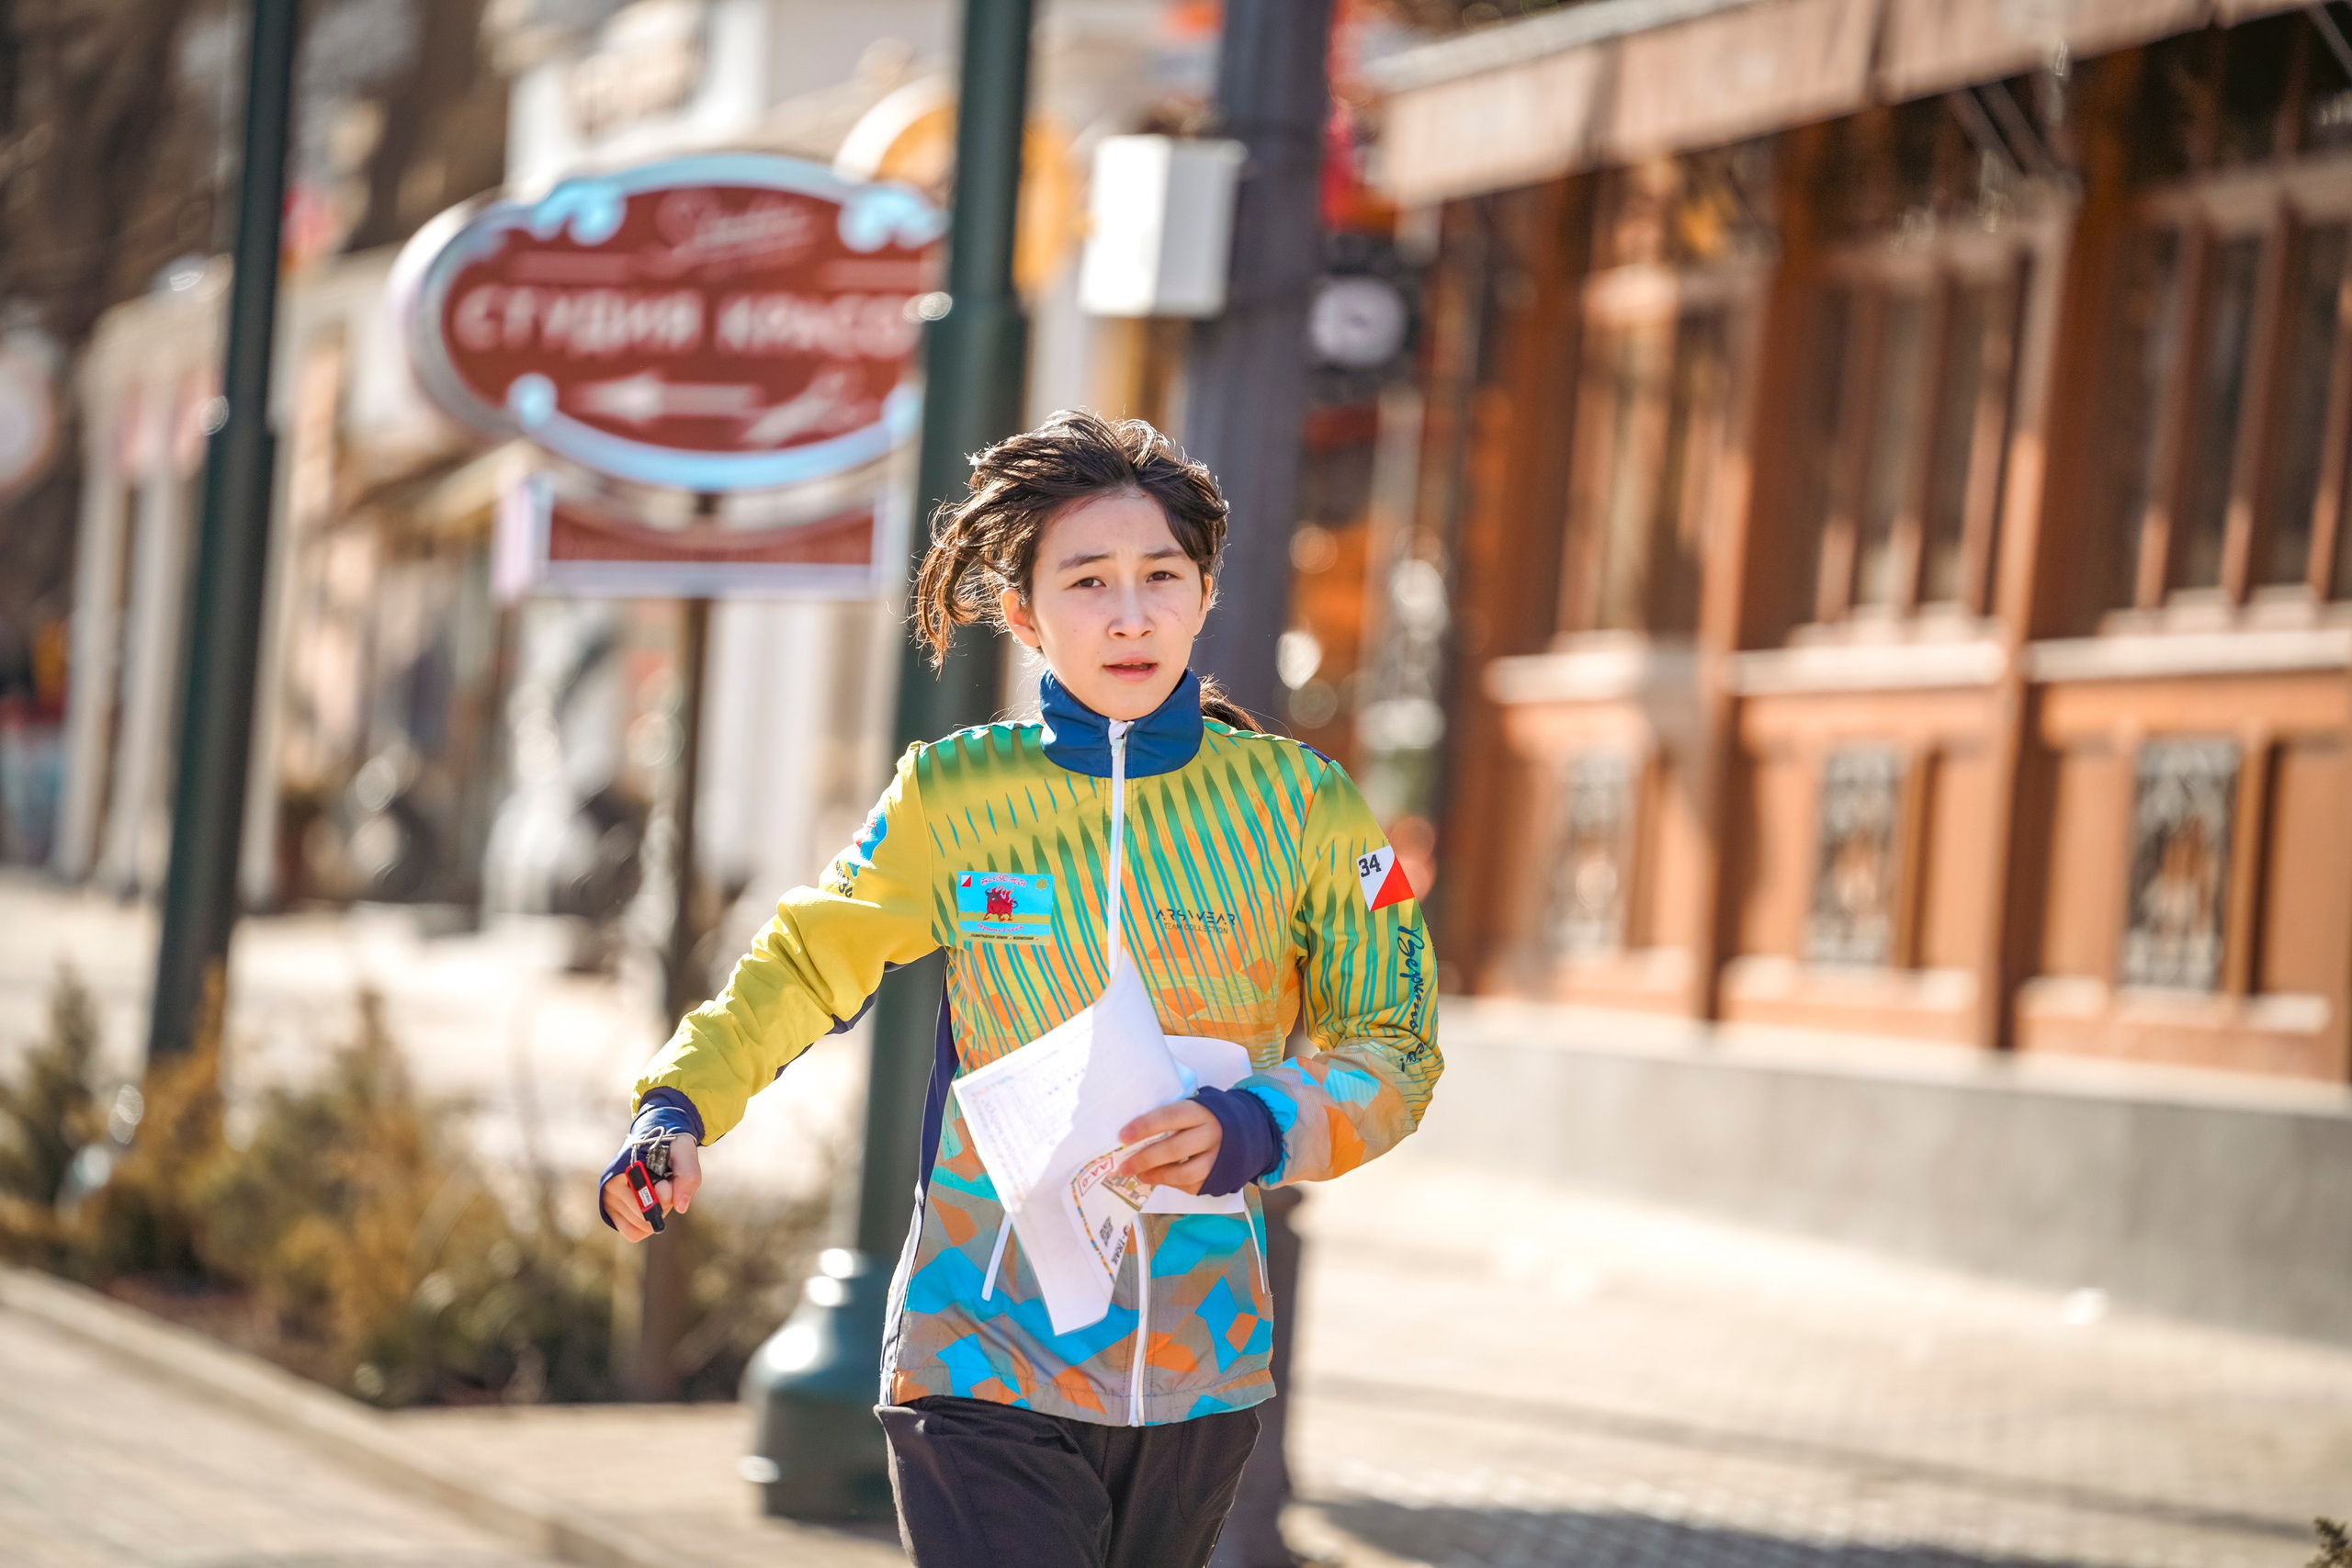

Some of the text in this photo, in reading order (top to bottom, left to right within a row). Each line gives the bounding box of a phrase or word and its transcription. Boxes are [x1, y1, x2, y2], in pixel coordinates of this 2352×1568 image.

[456, 289, 703, 355] СТУДИЯ
[1358, 853, 1382, 878] 34
[1183, 924, 1228, 934] COLLECTION
